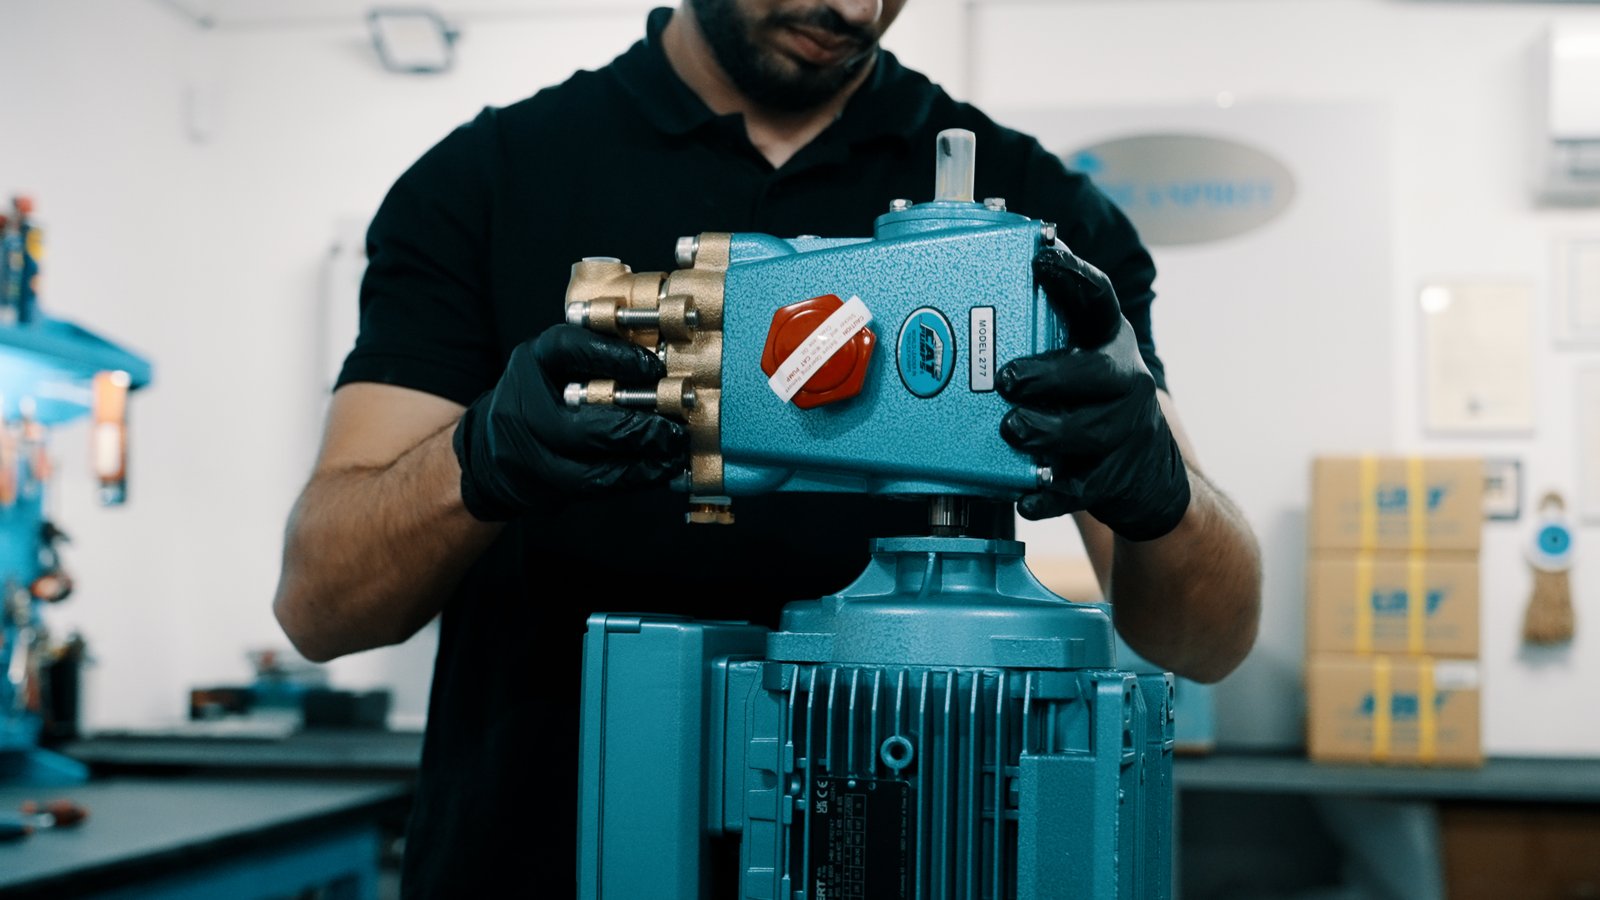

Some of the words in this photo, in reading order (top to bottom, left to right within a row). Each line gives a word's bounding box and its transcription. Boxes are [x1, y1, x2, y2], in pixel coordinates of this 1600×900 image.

[842, 314, 863, 336] CAUTION
[978, 320, 987, 354] MODEL
[800, 356, 810, 366] CAT
[925, 327, 934, 378] CAT
[785, 367, 799, 381] PUMP
[978, 358, 987, 377] 277
[816, 780, 828, 798] CE
